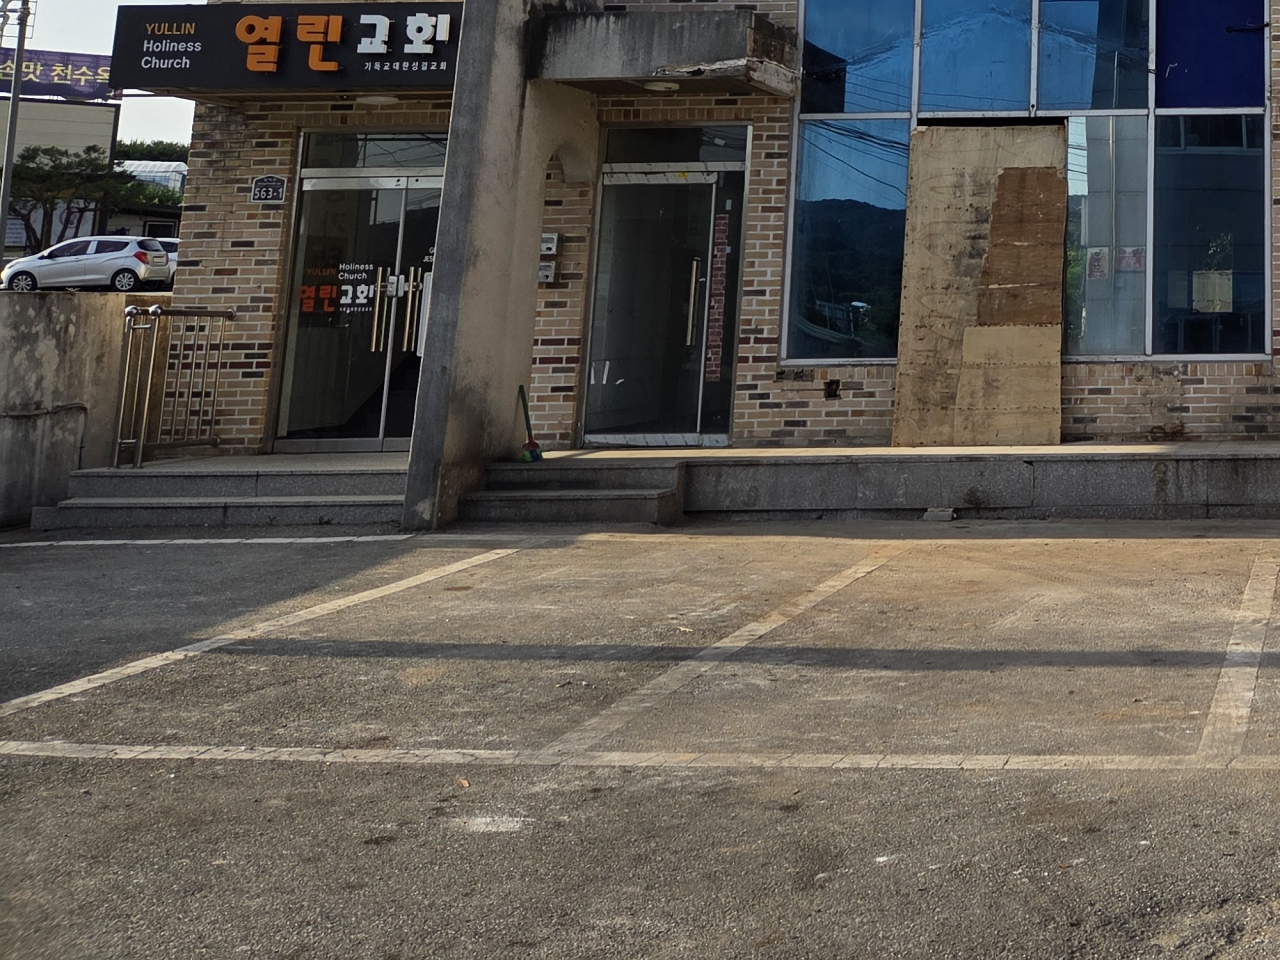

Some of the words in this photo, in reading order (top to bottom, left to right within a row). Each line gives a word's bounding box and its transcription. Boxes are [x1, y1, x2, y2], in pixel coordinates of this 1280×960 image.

[145, 23, 196, 35] YULLIN
[143, 40, 202, 52] Holiness
[141, 56, 190, 69] Church
[254, 187, 283, 199] 563-1
[339, 263, 374, 271] Holiness
[338, 271, 368, 280] Church
